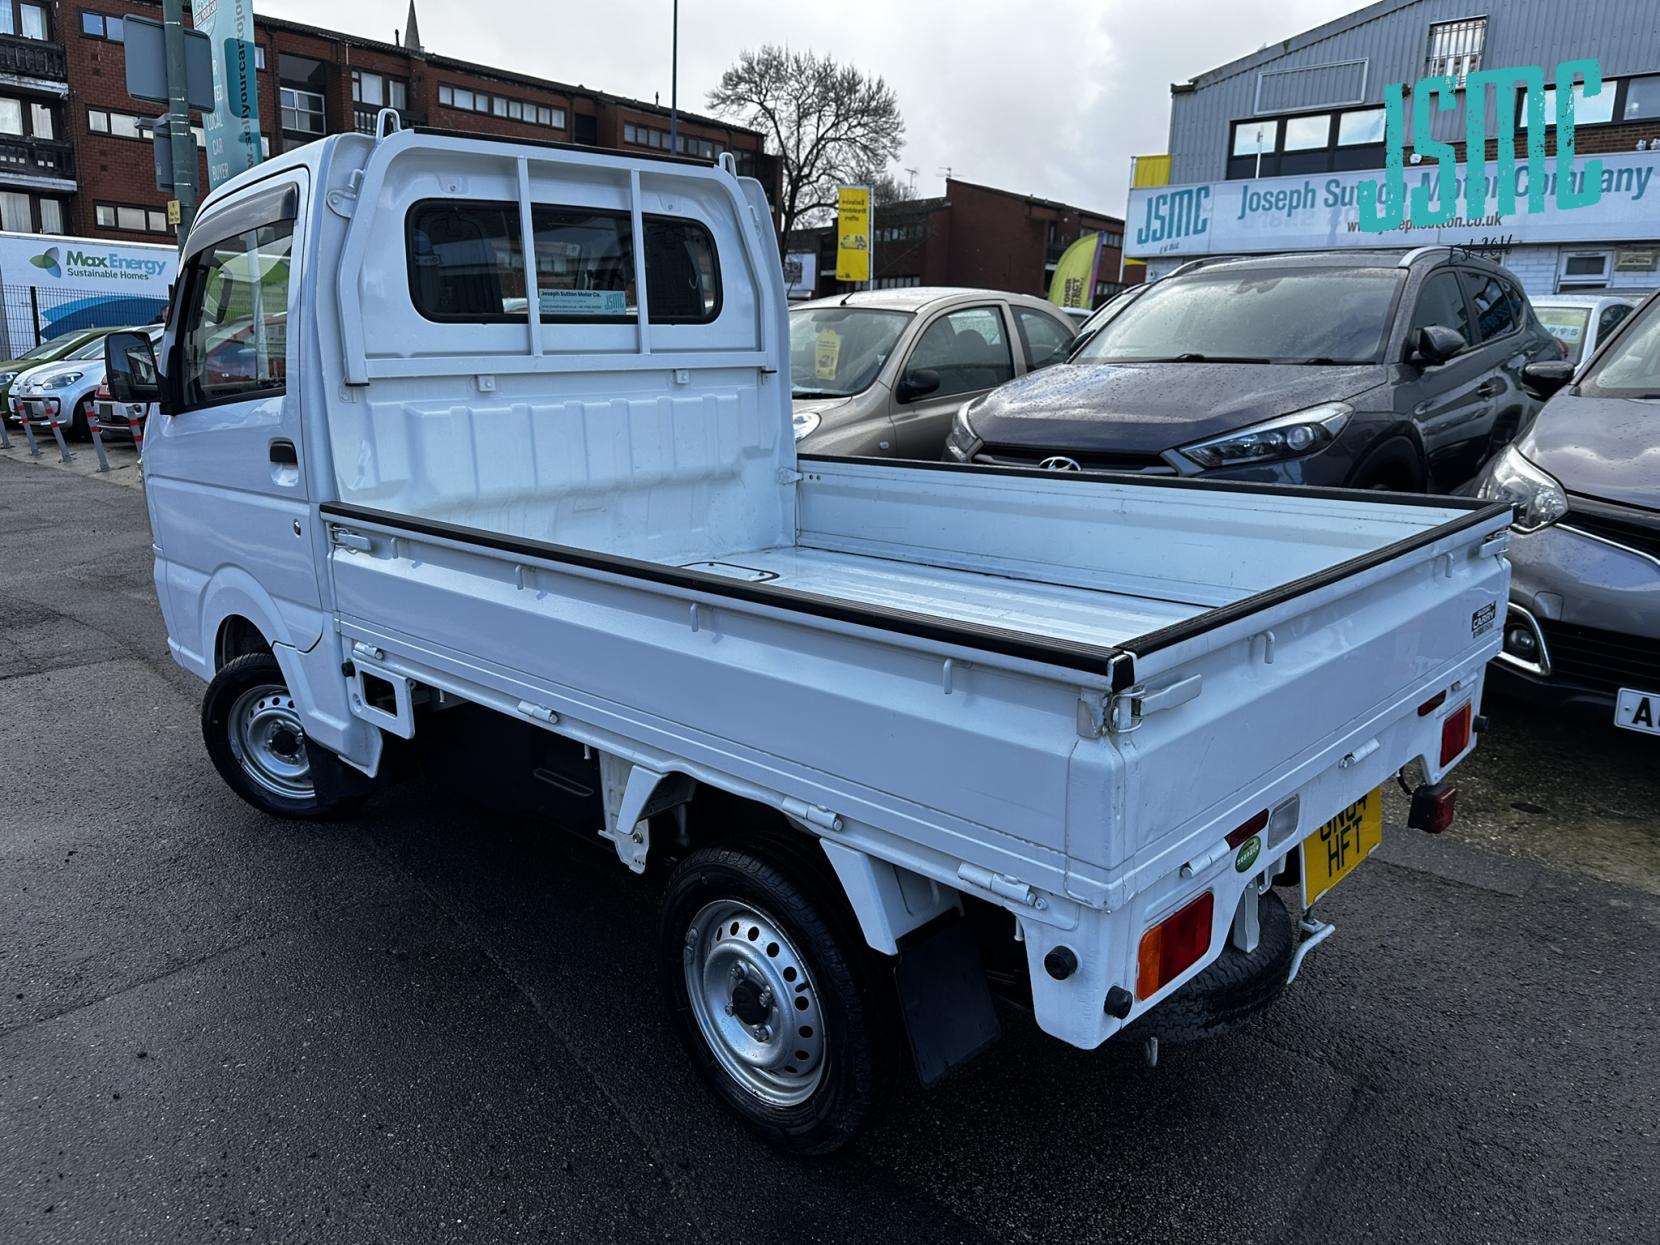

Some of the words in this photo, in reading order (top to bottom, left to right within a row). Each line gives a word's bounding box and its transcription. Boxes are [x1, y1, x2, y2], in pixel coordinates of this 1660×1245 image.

[206, 112, 223, 131] LOCAL
[212, 138, 223, 155] CAR
[212, 162, 228, 181] BUYER
[1238, 181, 1316, 219] Joseph
[1323, 178, 1408, 208] Suo
[1137, 186, 1210, 245] JSMC
[67, 268, 118, 279] Sustainable
[120, 271, 149, 280] Homes
[540, 291, 560, 299] Joseph
[604, 293, 625, 310] JSMC
[1472, 609, 1495, 630] CARRY
[1632, 696, 1660, 728] A
[1328, 815, 1363, 878] HFT
